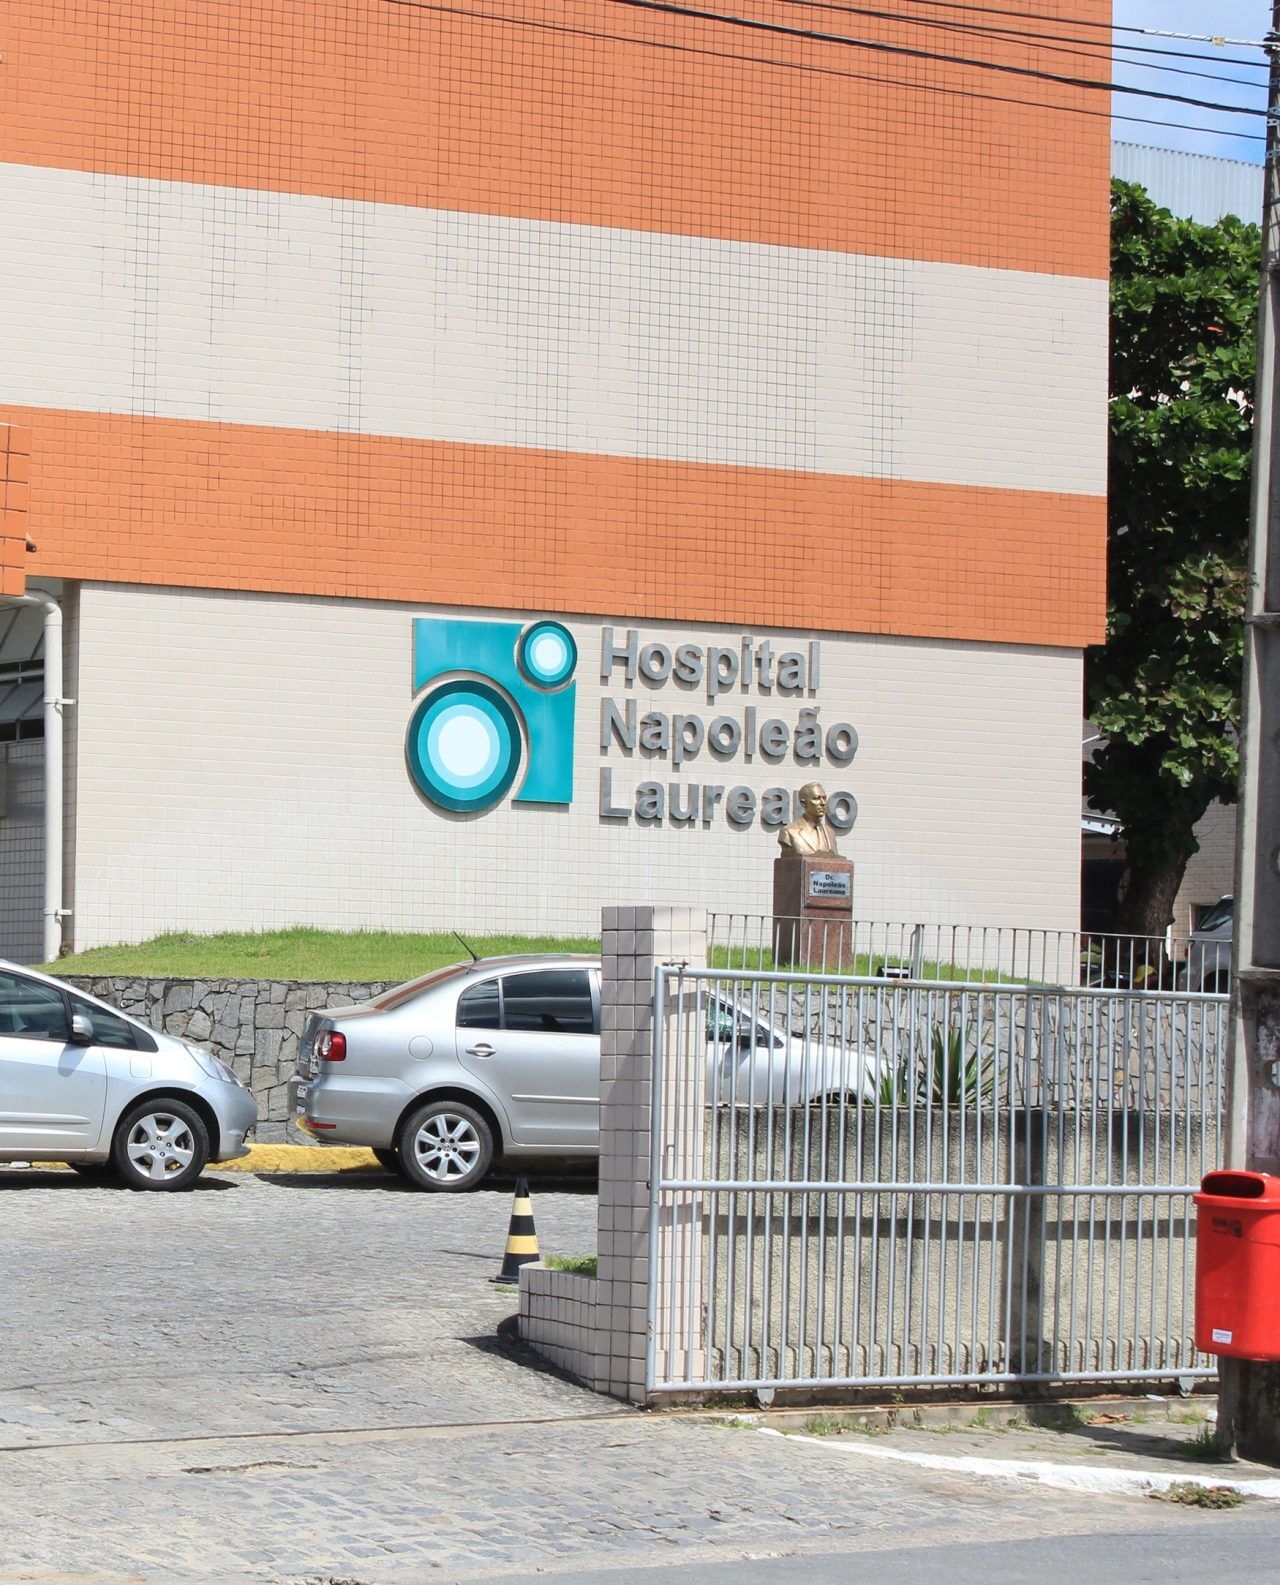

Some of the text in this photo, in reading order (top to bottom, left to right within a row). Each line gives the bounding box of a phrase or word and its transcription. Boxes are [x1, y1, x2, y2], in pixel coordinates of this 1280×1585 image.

[601, 626, 820, 697] Hospital
[600, 697, 860, 764] Napoleão
[599, 766, 859, 829] Laureao
